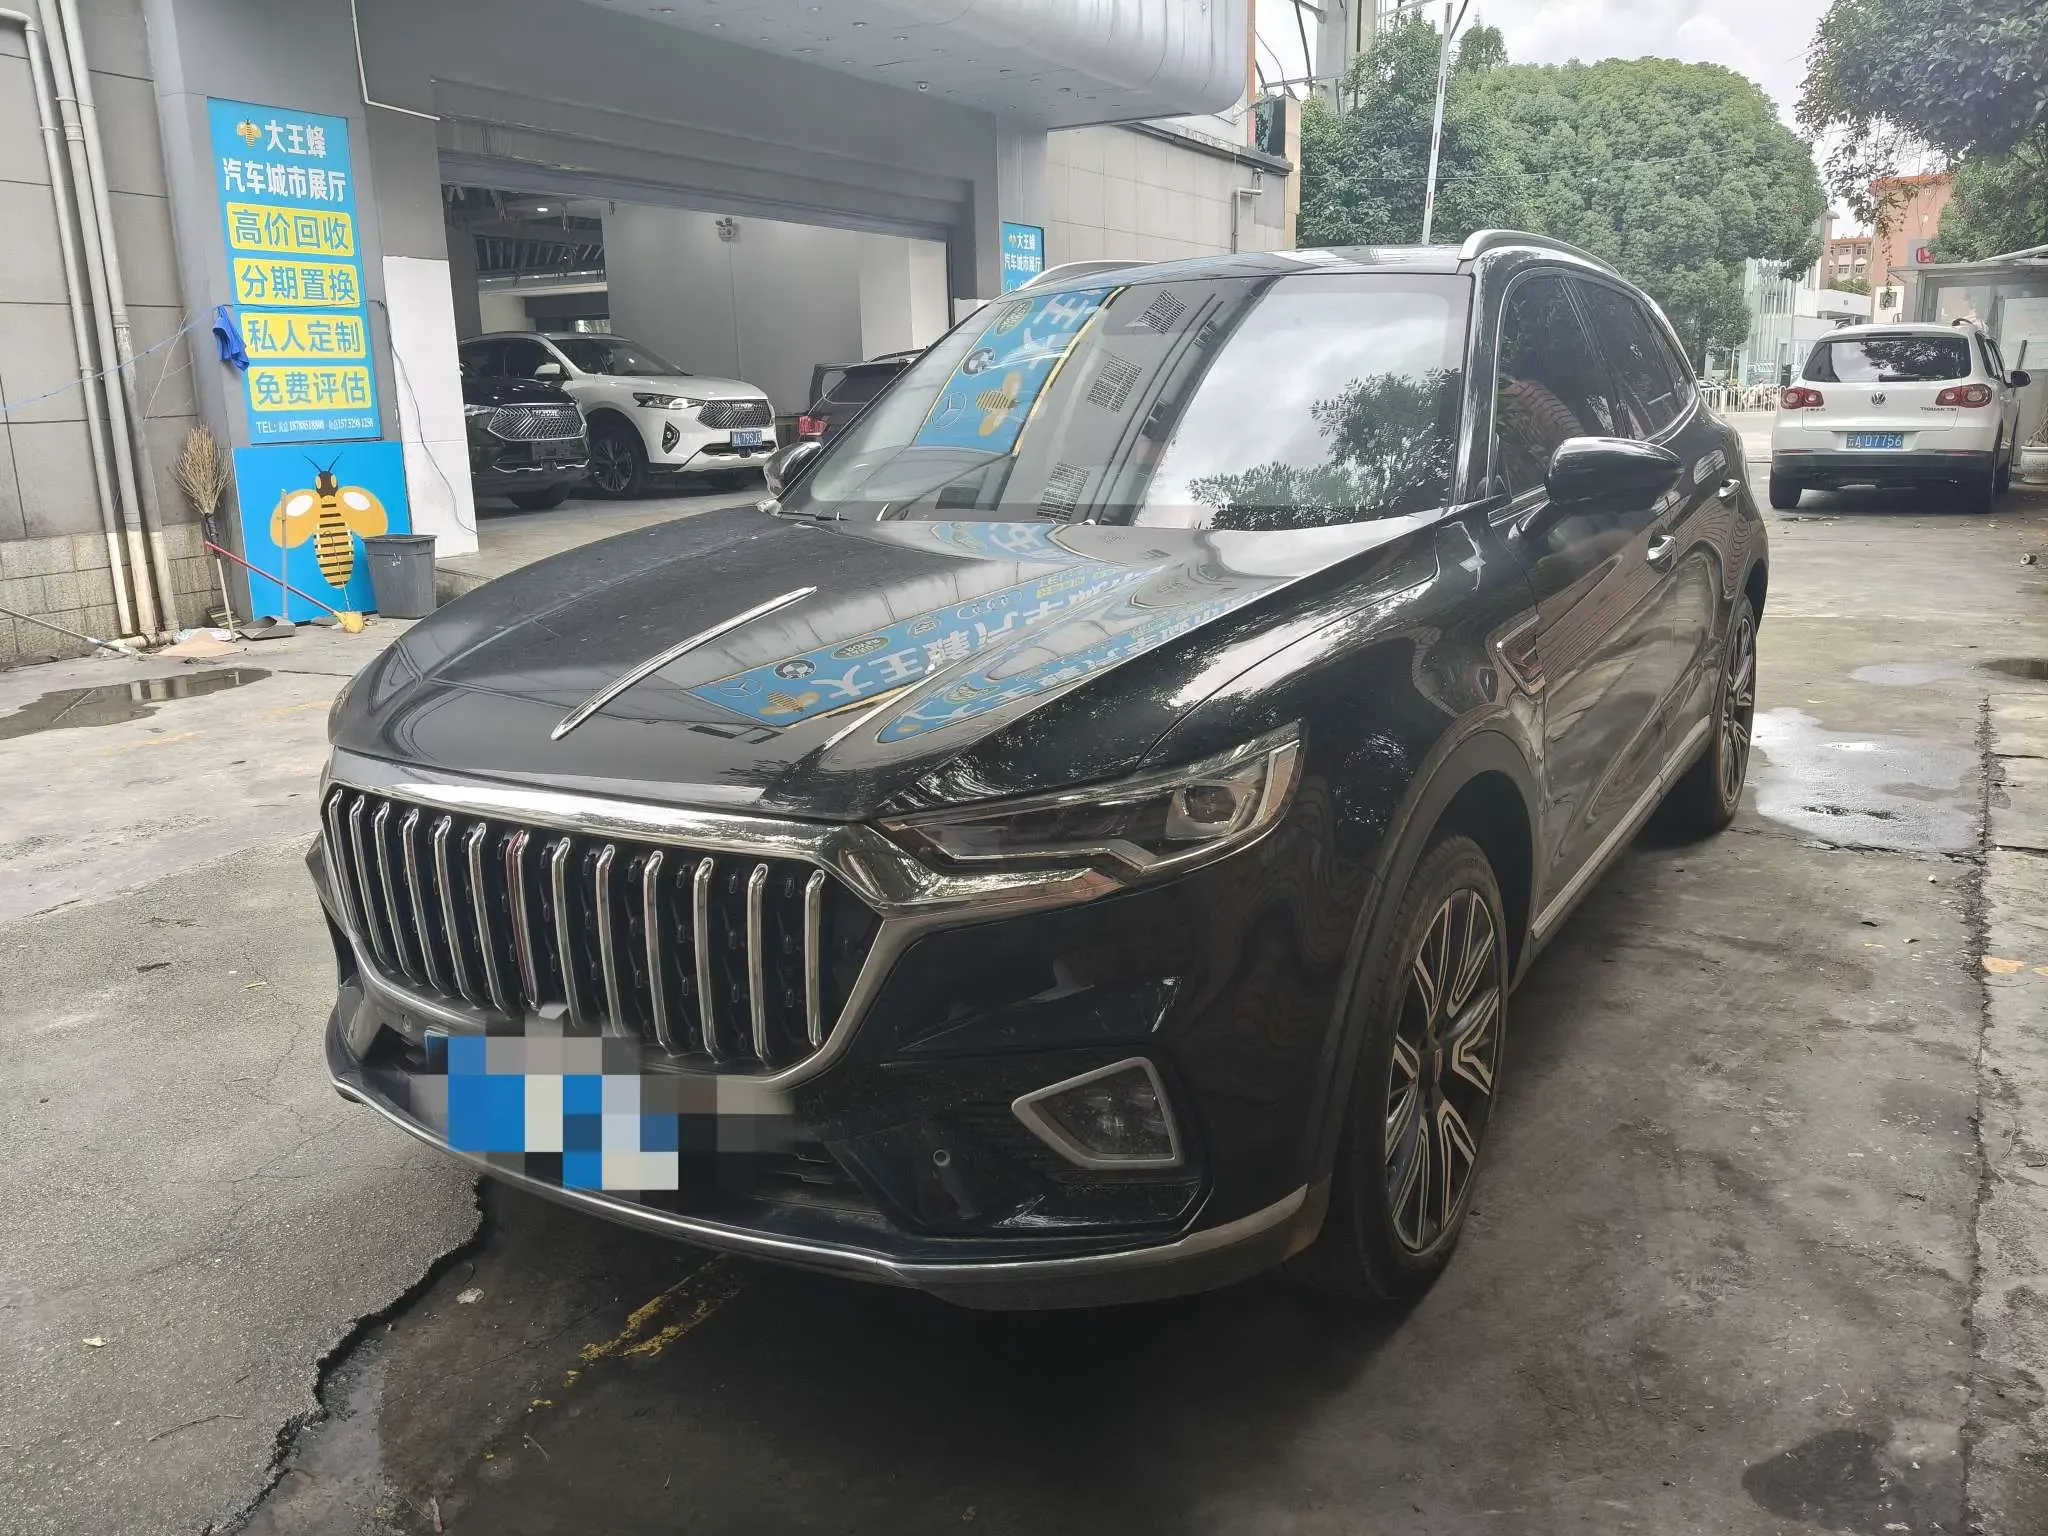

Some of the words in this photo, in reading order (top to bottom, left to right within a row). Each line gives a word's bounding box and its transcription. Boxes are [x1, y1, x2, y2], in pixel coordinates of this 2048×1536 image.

[264, 119, 328, 159] 大王蜂
[222, 157, 346, 202] 汽车城市展厅
[231, 208, 350, 251] 高价回收
[240, 264, 356, 302] 分期置换
[247, 318, 361, 354] 私人定制
[254, 370, 366, 406] 免费评估
